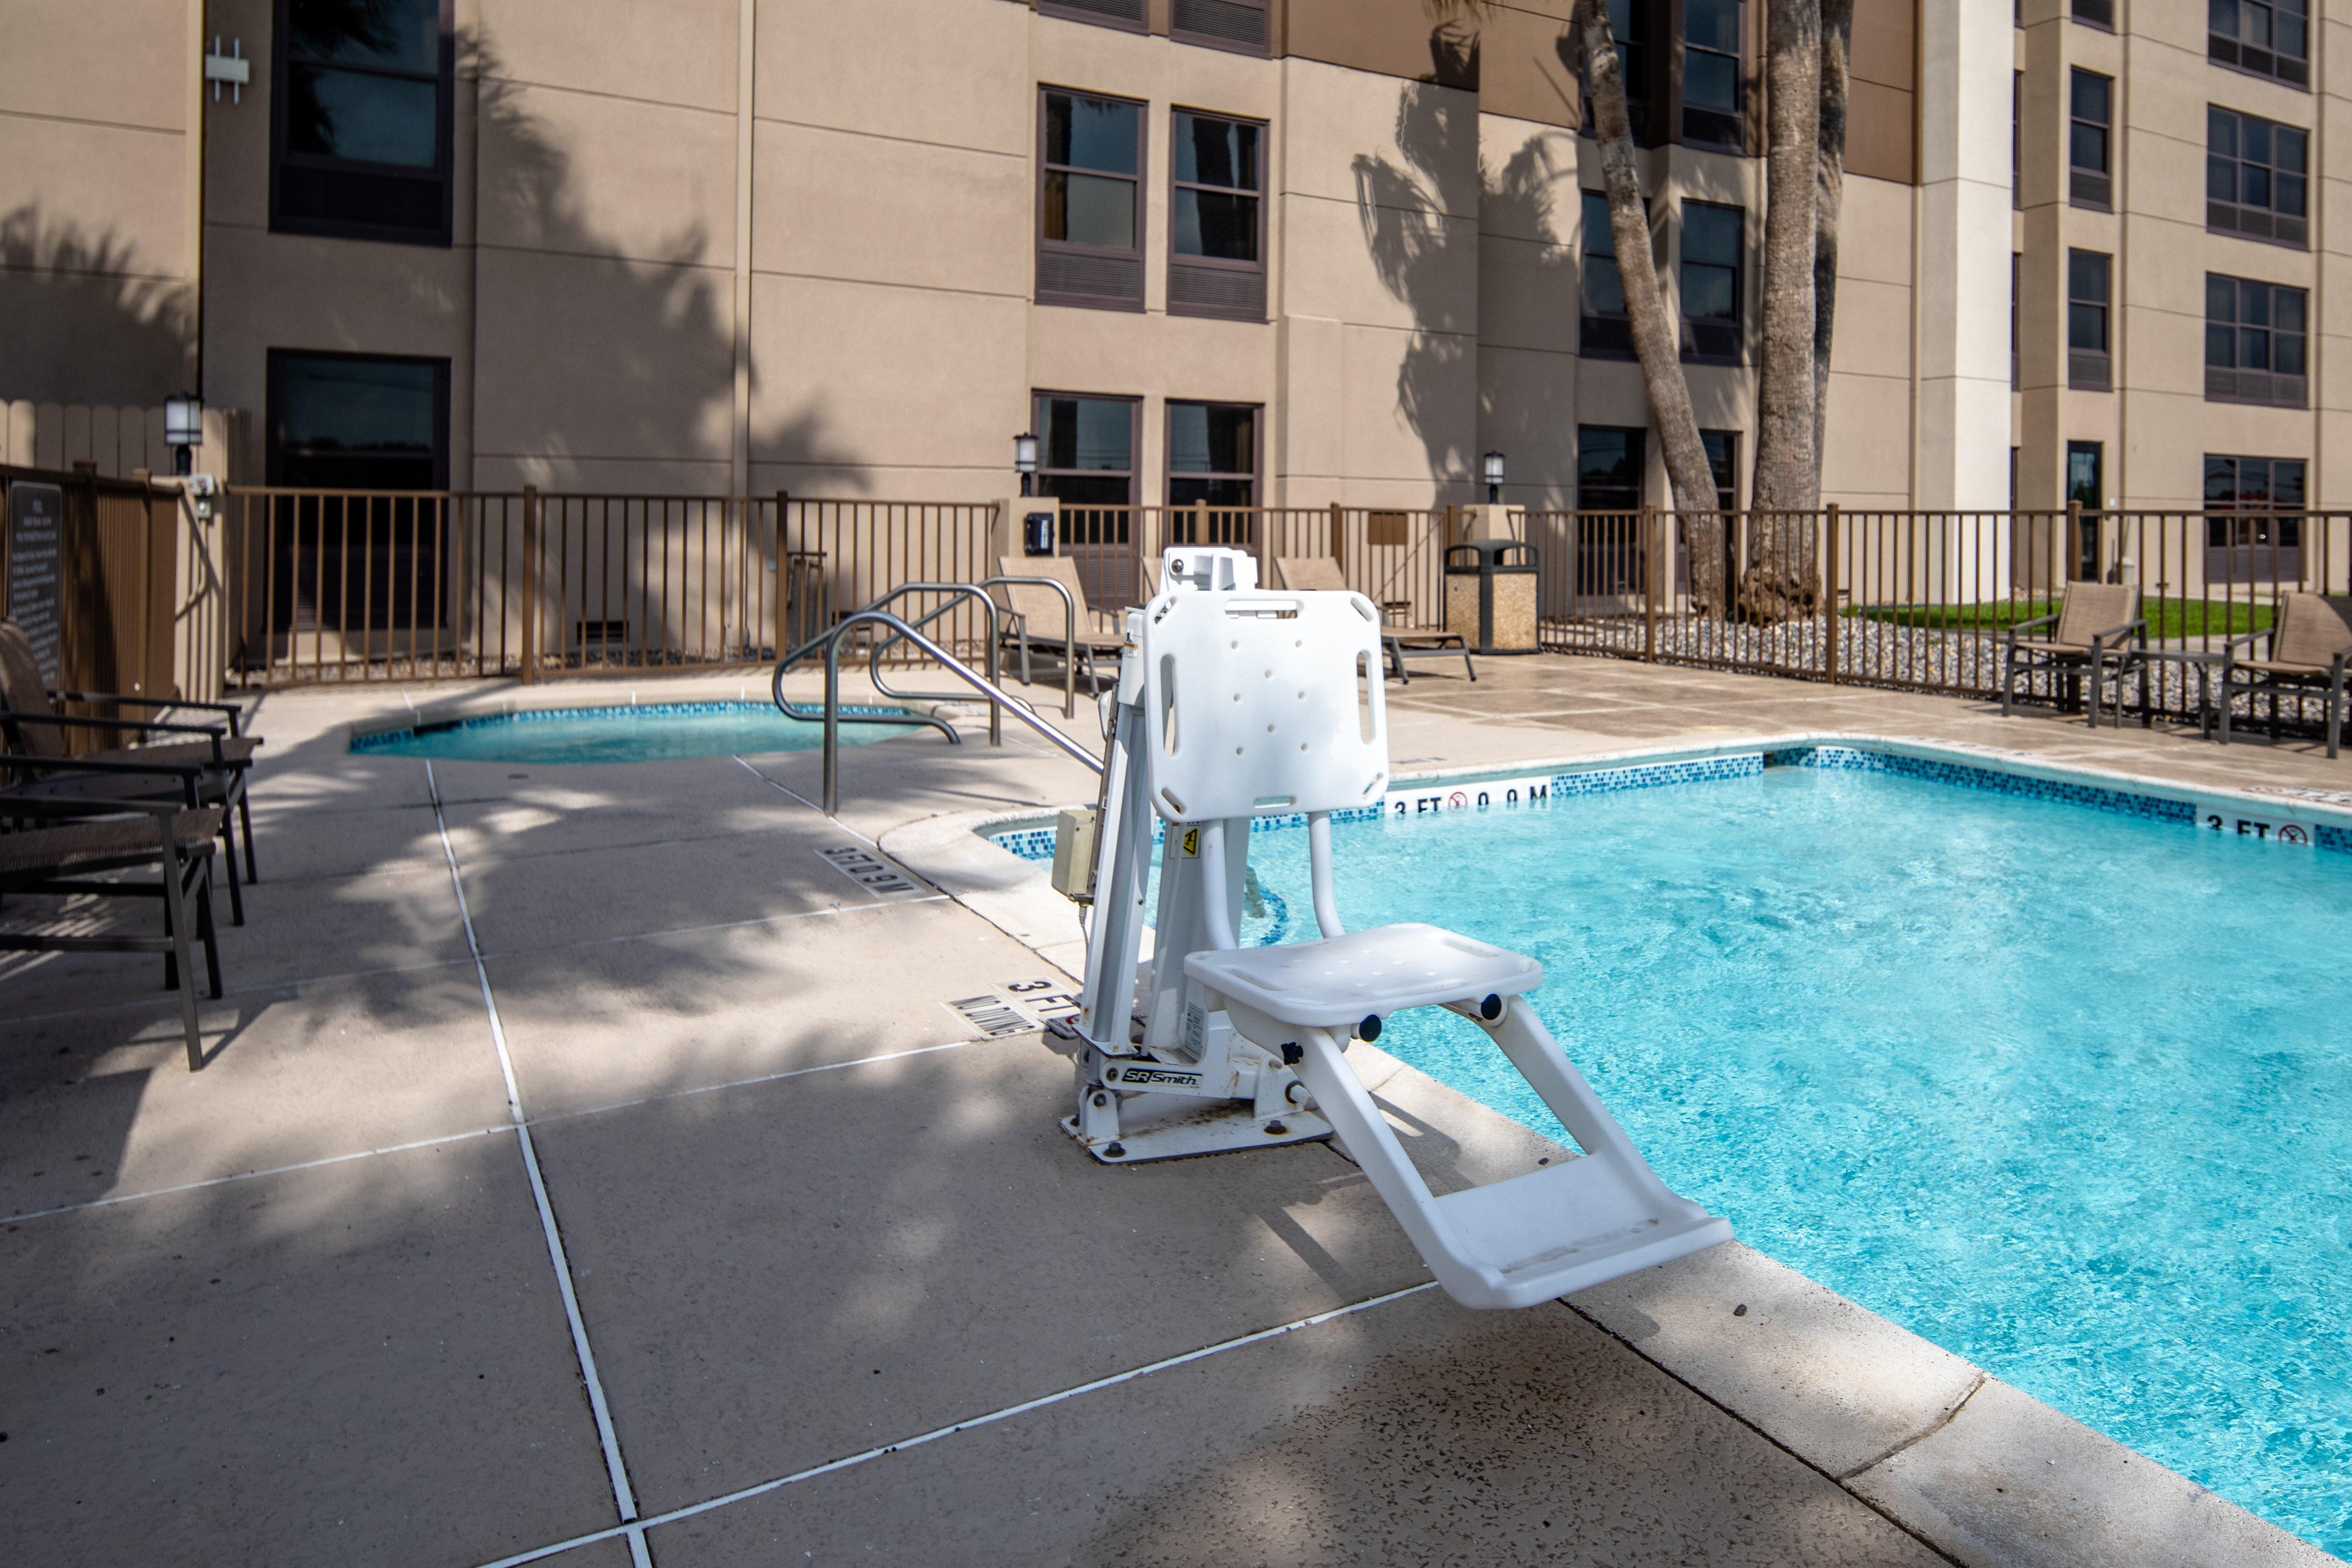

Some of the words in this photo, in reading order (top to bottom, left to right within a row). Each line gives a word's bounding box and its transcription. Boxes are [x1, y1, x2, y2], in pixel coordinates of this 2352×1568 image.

[1417, 796, 1442, 813] FT
[1529, 785, 1547, 800] M
[2237, 819, 2271, 838] FT
[1008, 981, 1052, 992] 3
[949, 994, 1002, 1009] NO
[1024, 994, 1081, 1013] FT
[964, 1007, 1036, 1036] DIVING
